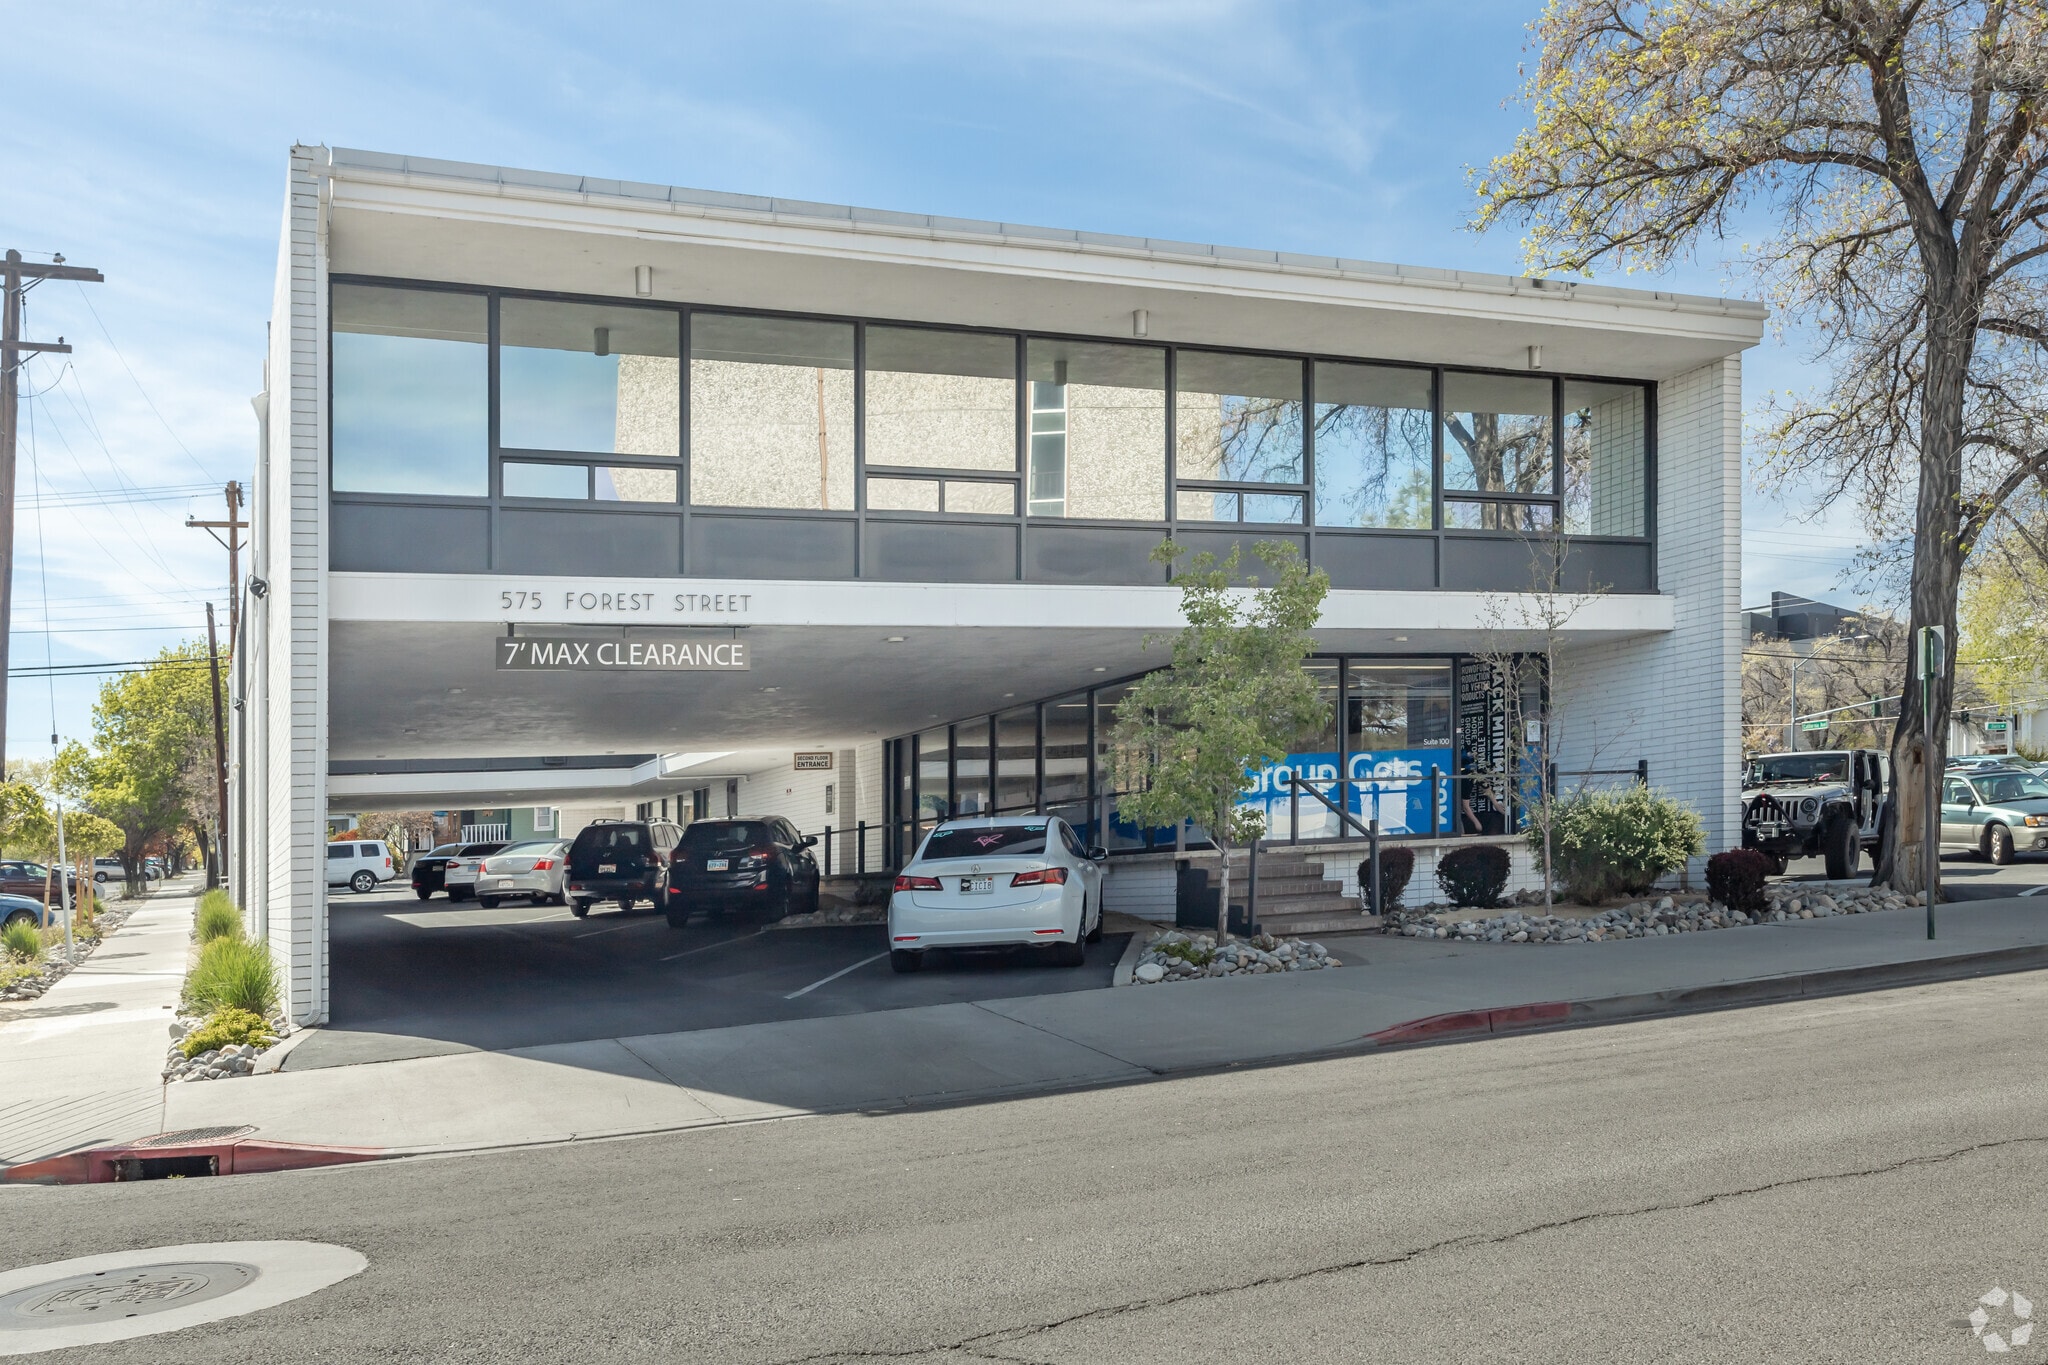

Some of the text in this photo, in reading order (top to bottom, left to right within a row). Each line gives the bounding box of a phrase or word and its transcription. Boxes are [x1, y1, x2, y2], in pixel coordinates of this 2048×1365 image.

[501, 591, 752, 612] 575 FOREST STREET
[504, 643, 744, 665] 7' MAX CLEARANCE
[1423, 738, 1438, 746] Suite
